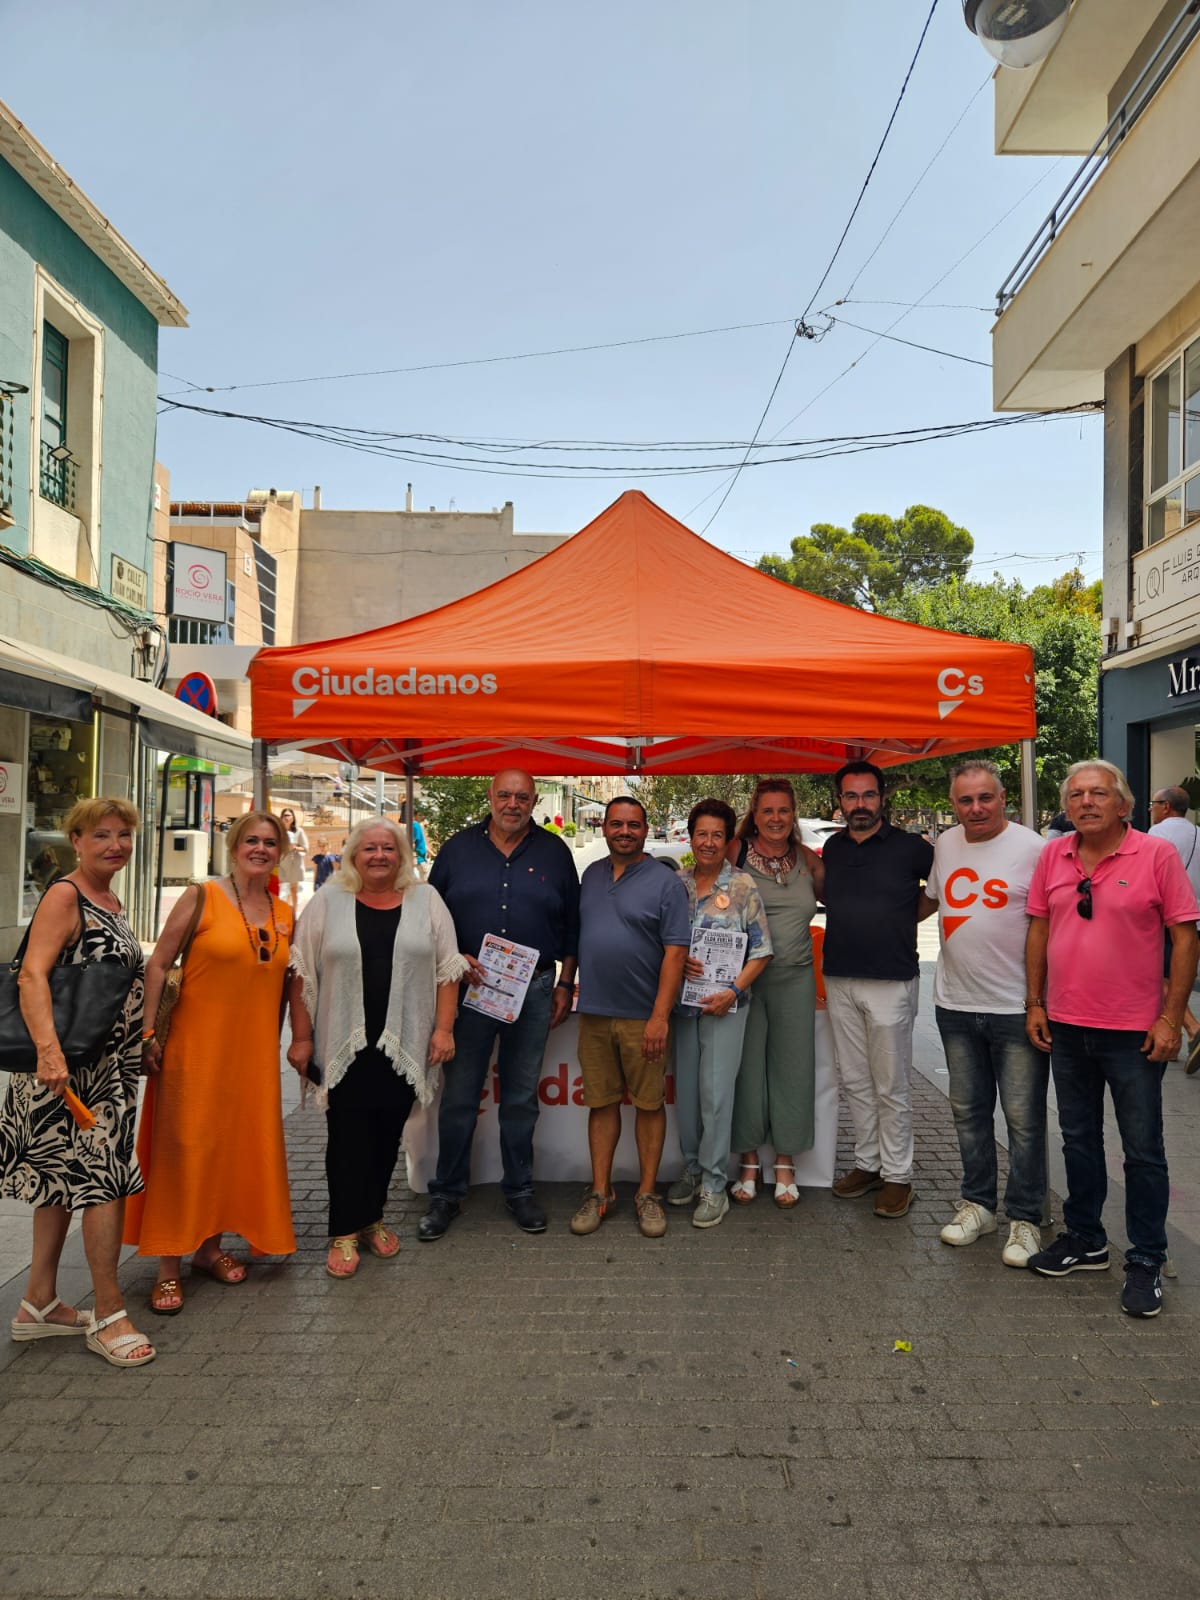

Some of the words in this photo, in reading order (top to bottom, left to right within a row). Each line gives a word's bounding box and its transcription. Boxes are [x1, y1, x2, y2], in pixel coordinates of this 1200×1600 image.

[1172, 548, 1193, 569] LUIS
[127, 567, 142, 588] CALLE
[113, 580, 125, 598] JUAN
[203, 592, 224, 601] VERA
[291, 666, 498, 696] Ciudadanos
[937, 667, 985, 697] Cs
[944, 867, 1009, 910] Cs
